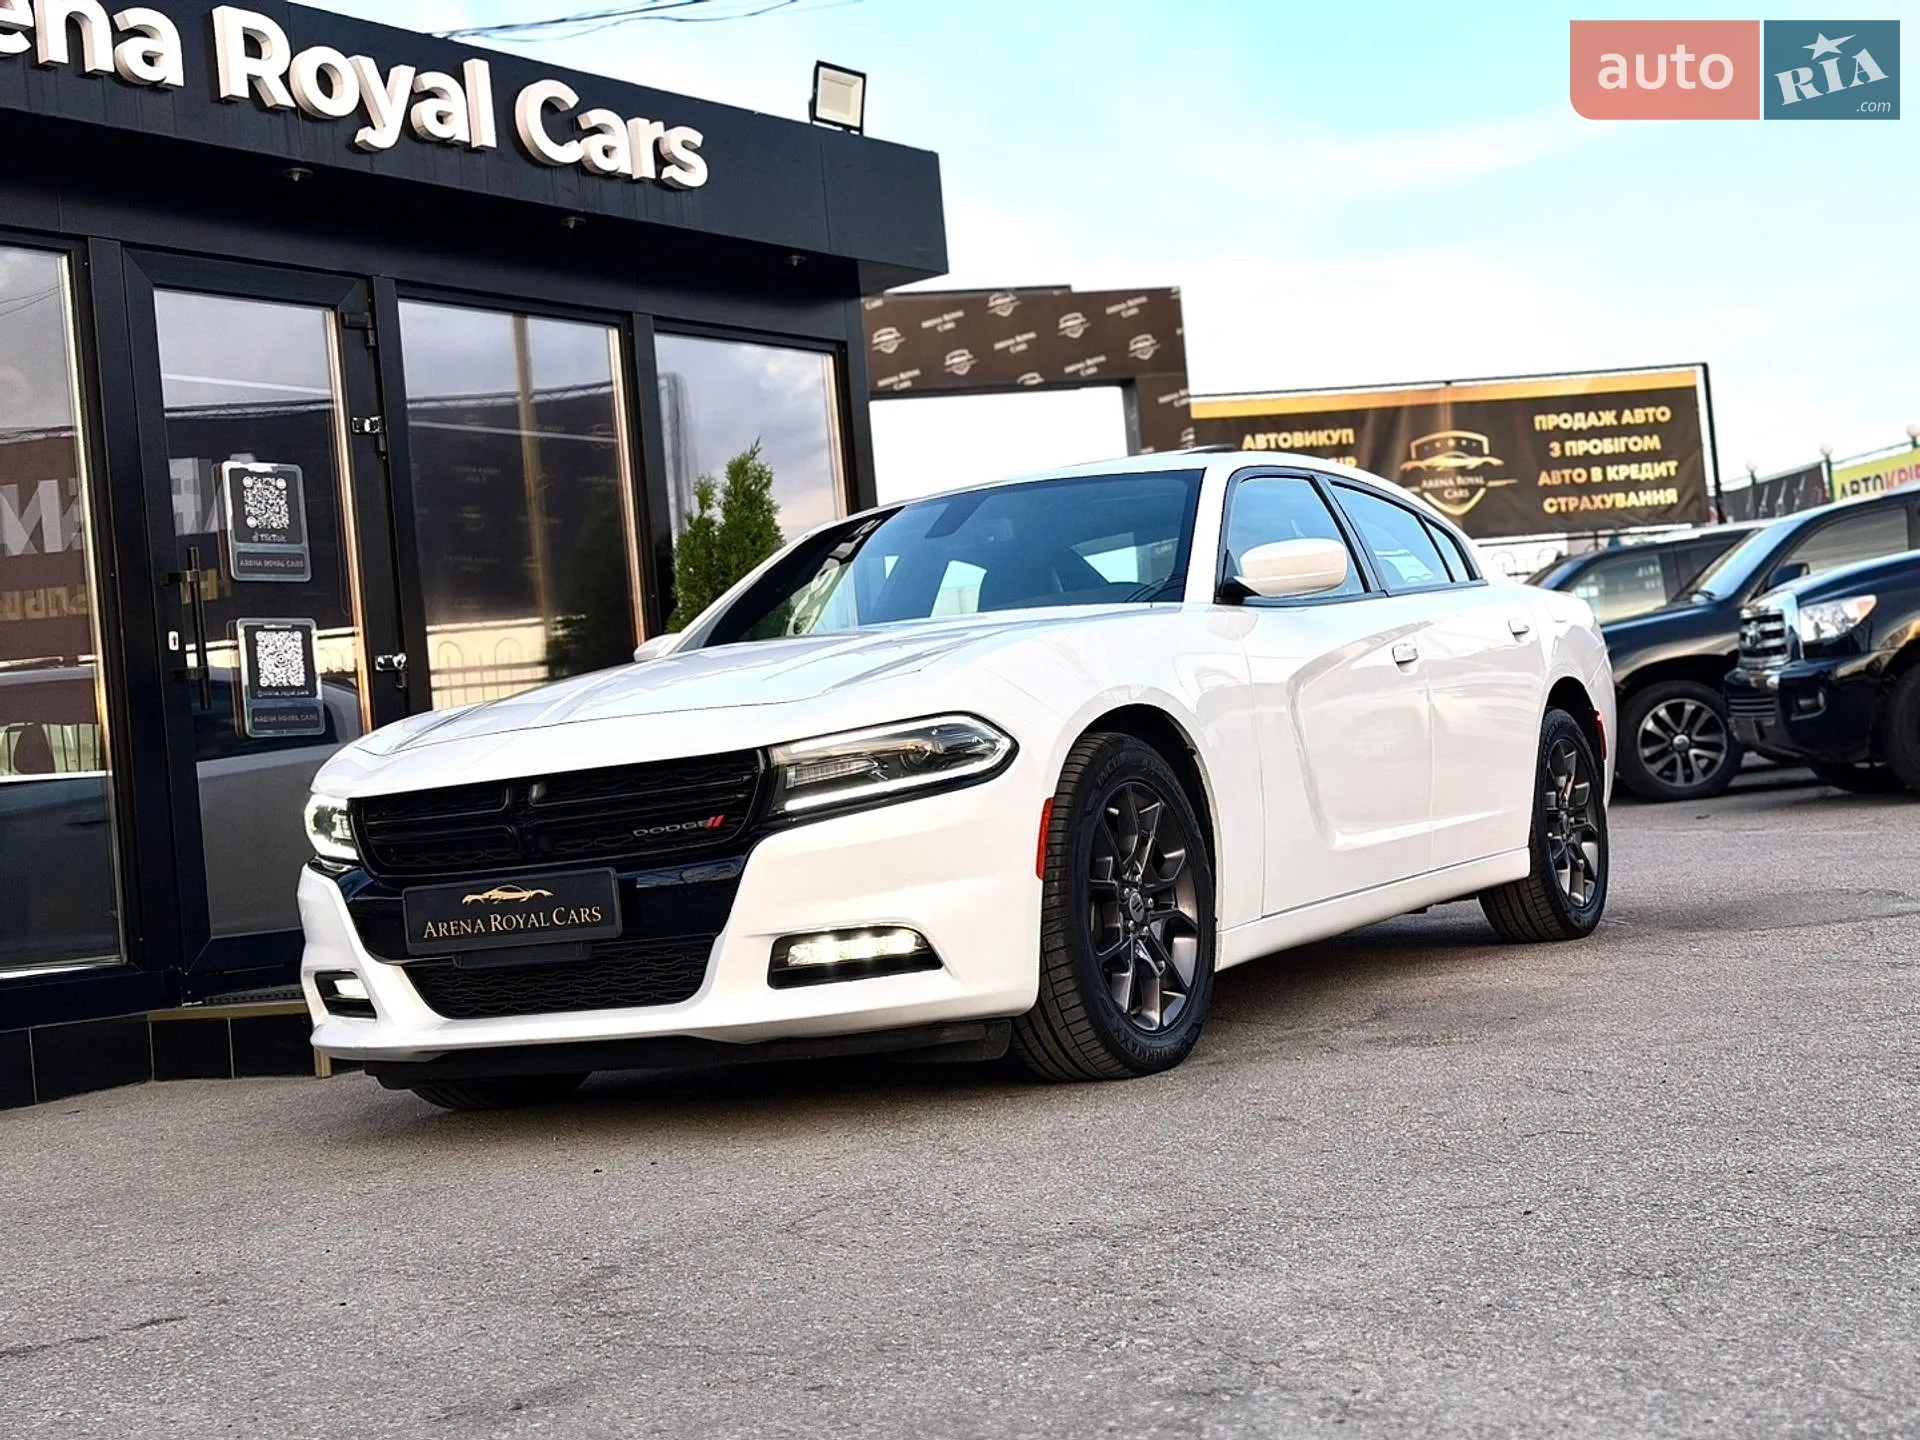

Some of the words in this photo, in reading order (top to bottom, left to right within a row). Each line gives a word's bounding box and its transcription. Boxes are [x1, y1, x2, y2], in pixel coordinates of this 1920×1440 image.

[211, 4, 498, 153] Royal
[514, 78, 711, 190] Cars
[1533, 409, 1618, 432] ПРОДАЖ
[1621, 405, 1672, 425] АВТО
[1241, 428, 1356, 451] АВТОВИКУП
[1548, 441, 1562, 458] З
[1564, 434, 1662, 457] ПРОБІГОМ
[1537, 467, 1588, 487] АВТО
[1590, 466, 1603, 483] В
[1605, 460, 1679, 481] КРЕДИТ
[1542, 487, 1679, 514] СТРАХУВАННЯ
[632, 818, 710, 838] DODGE
[423, 919, 486, 940] ARENA
[489, 912, 551, 933] ROYAL
[552, 905, 603, 926] CARS
